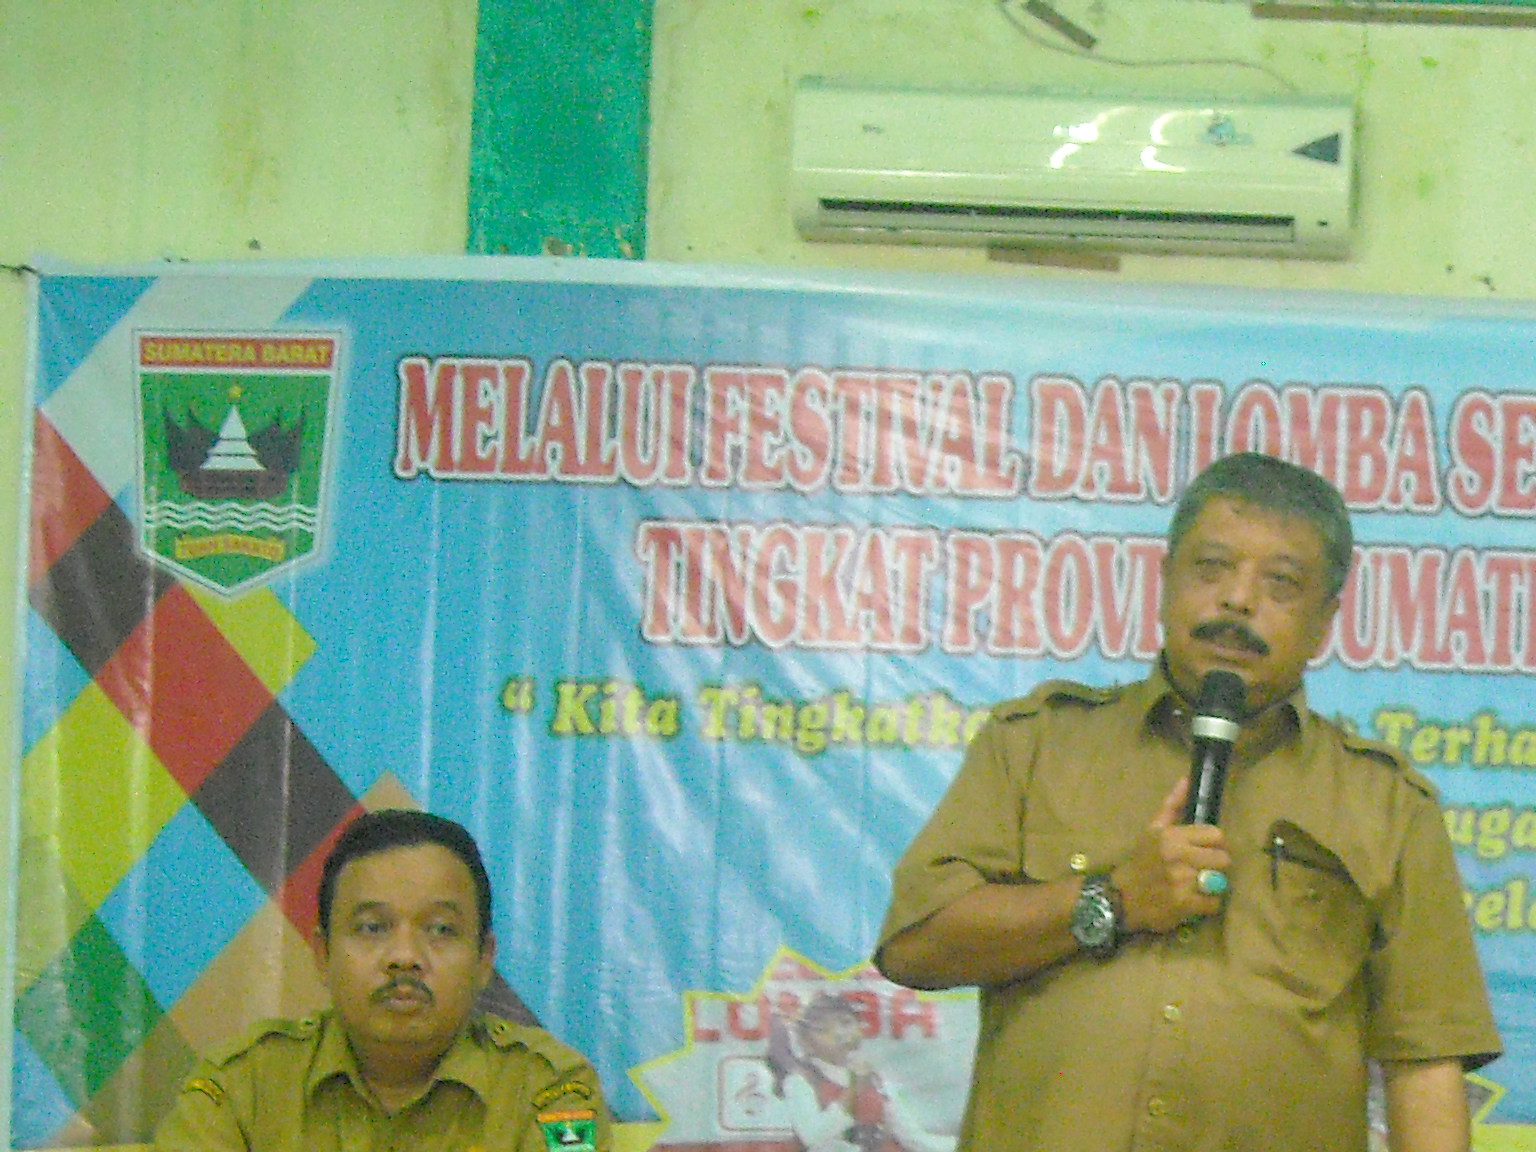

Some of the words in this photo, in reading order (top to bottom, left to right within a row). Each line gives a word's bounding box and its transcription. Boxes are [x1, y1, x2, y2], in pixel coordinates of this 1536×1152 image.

[398, 360, 692, 485] MELALUI
[703, 367, 1016, 494] FESTIVAL
[1031, 377, 1178, 503] DAN
[637, 522, 939, 651] TINGKAT
[553, 683, 679, 736] Kita
